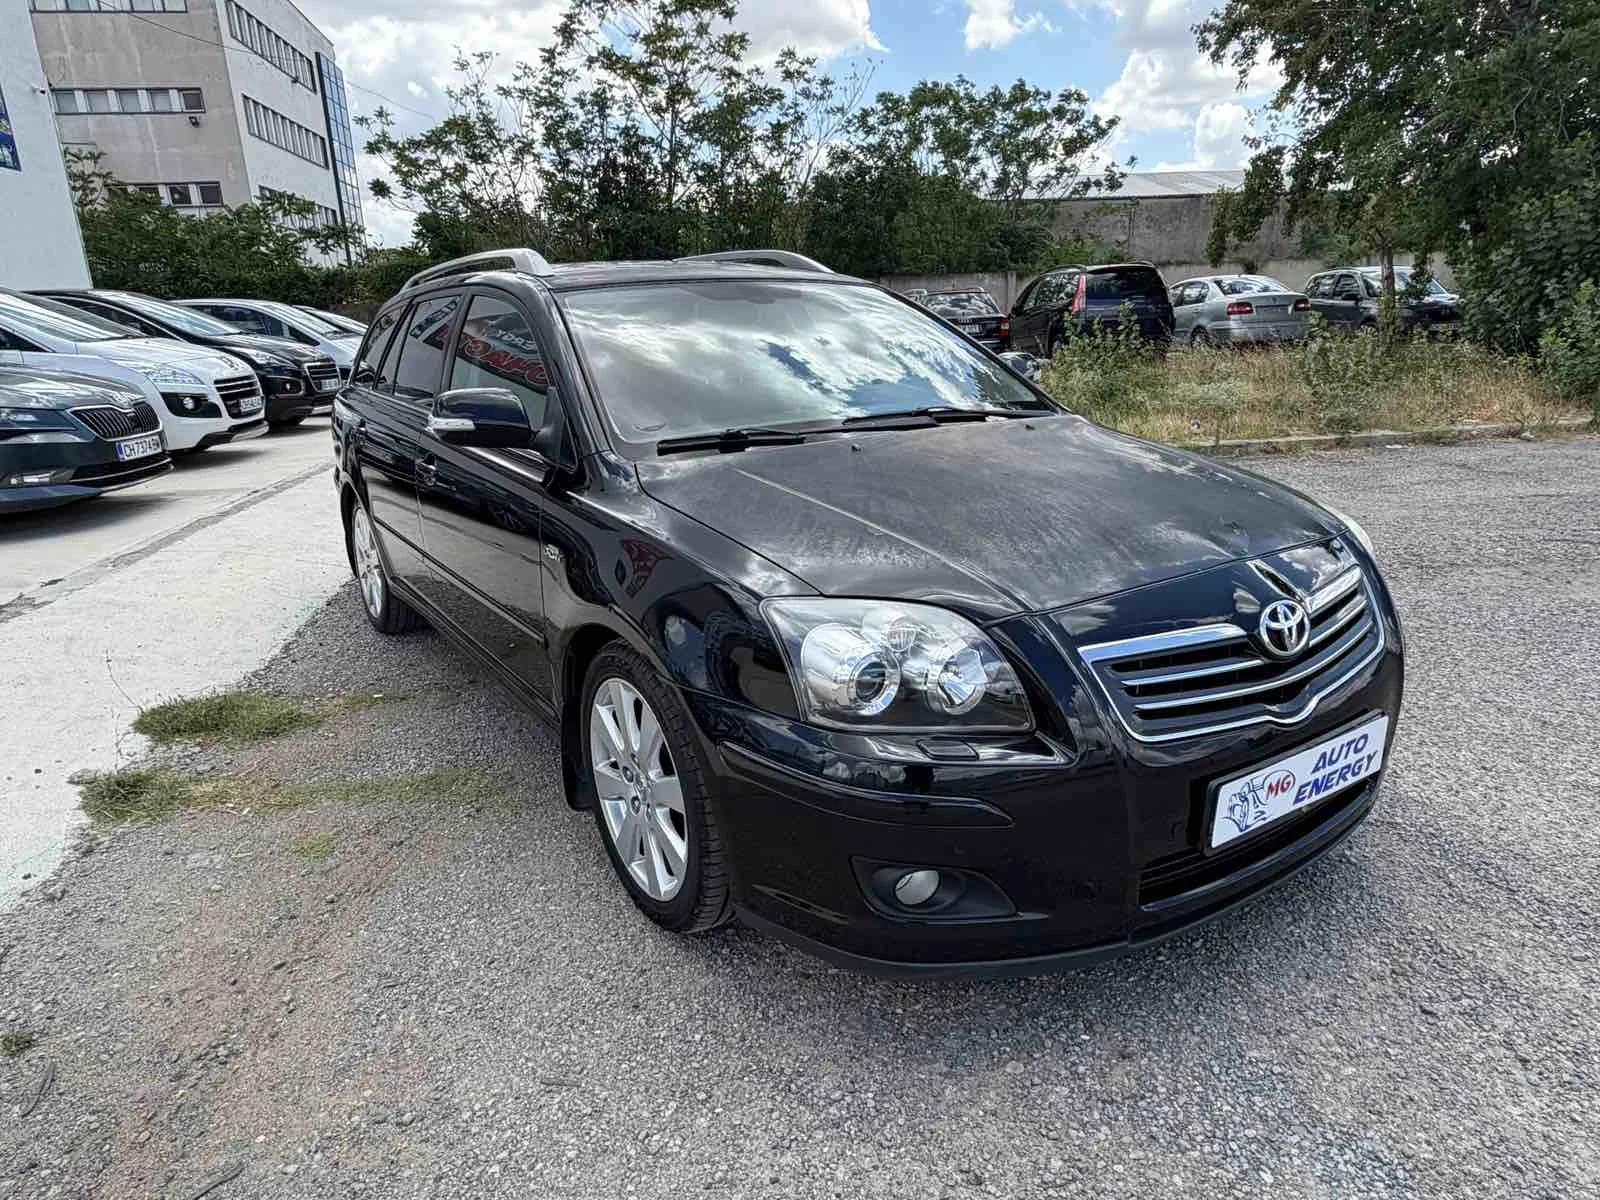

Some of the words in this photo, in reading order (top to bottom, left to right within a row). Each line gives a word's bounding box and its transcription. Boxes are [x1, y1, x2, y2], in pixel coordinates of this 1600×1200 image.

[1311, 733, 1369, 774] AUTO
[1266, 774, 1291, 801] MG
[1293, 750, 1378, 805] ENERGY
